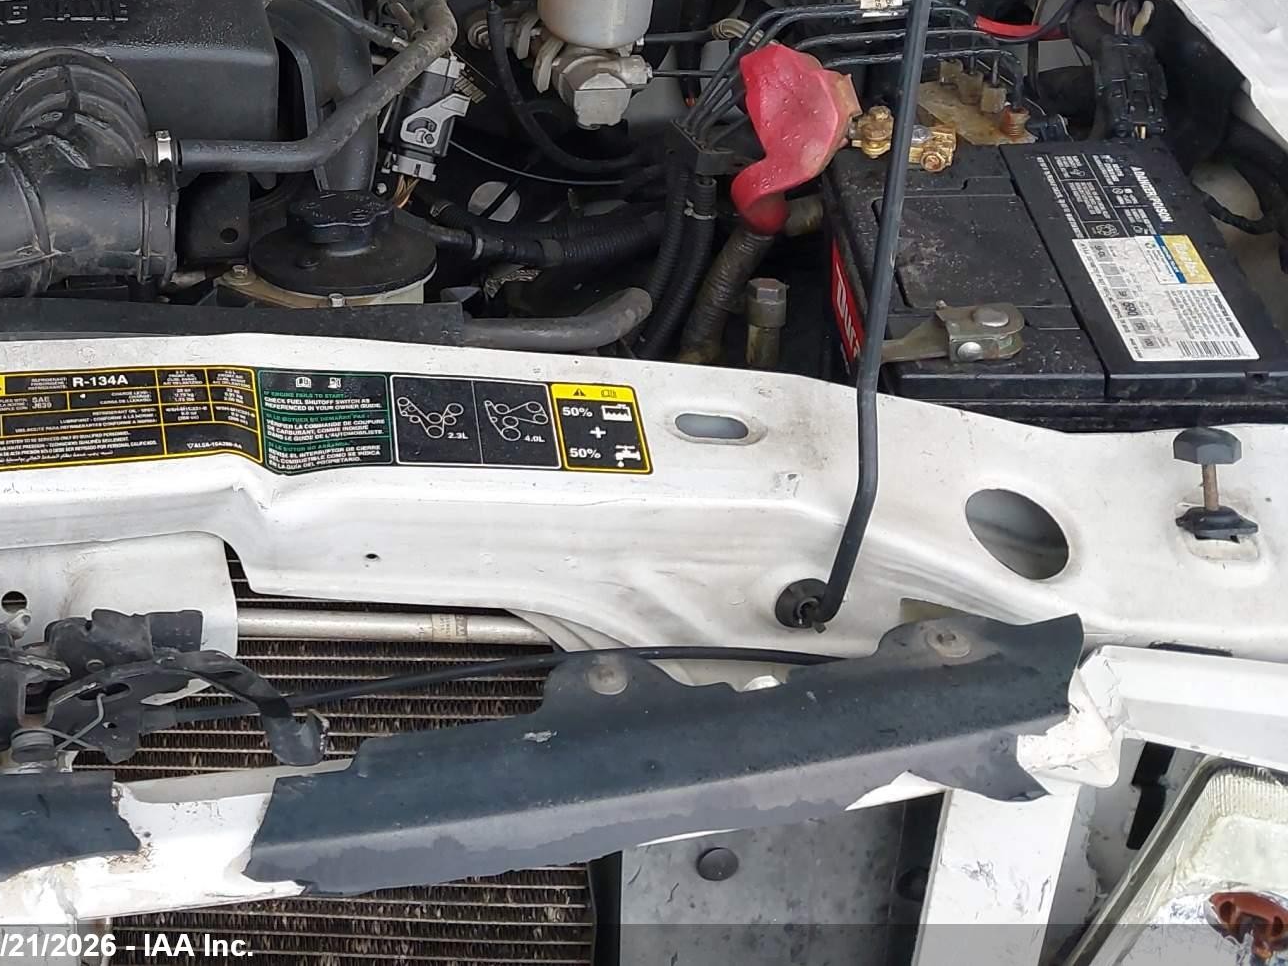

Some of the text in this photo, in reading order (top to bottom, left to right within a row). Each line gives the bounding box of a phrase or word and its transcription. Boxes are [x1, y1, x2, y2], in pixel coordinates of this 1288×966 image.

[72, 374, 129, 387] R-134A
[264, 396, 286, 404] CHECK
[264, 401, 307, 411] REFERENCED
[562, 406, 593, 418] 50%
[447, 431, 469, 440] 2.3L
[523, 435, 546, 443] 4.0L
[569, 447, 602, 459] 50%
